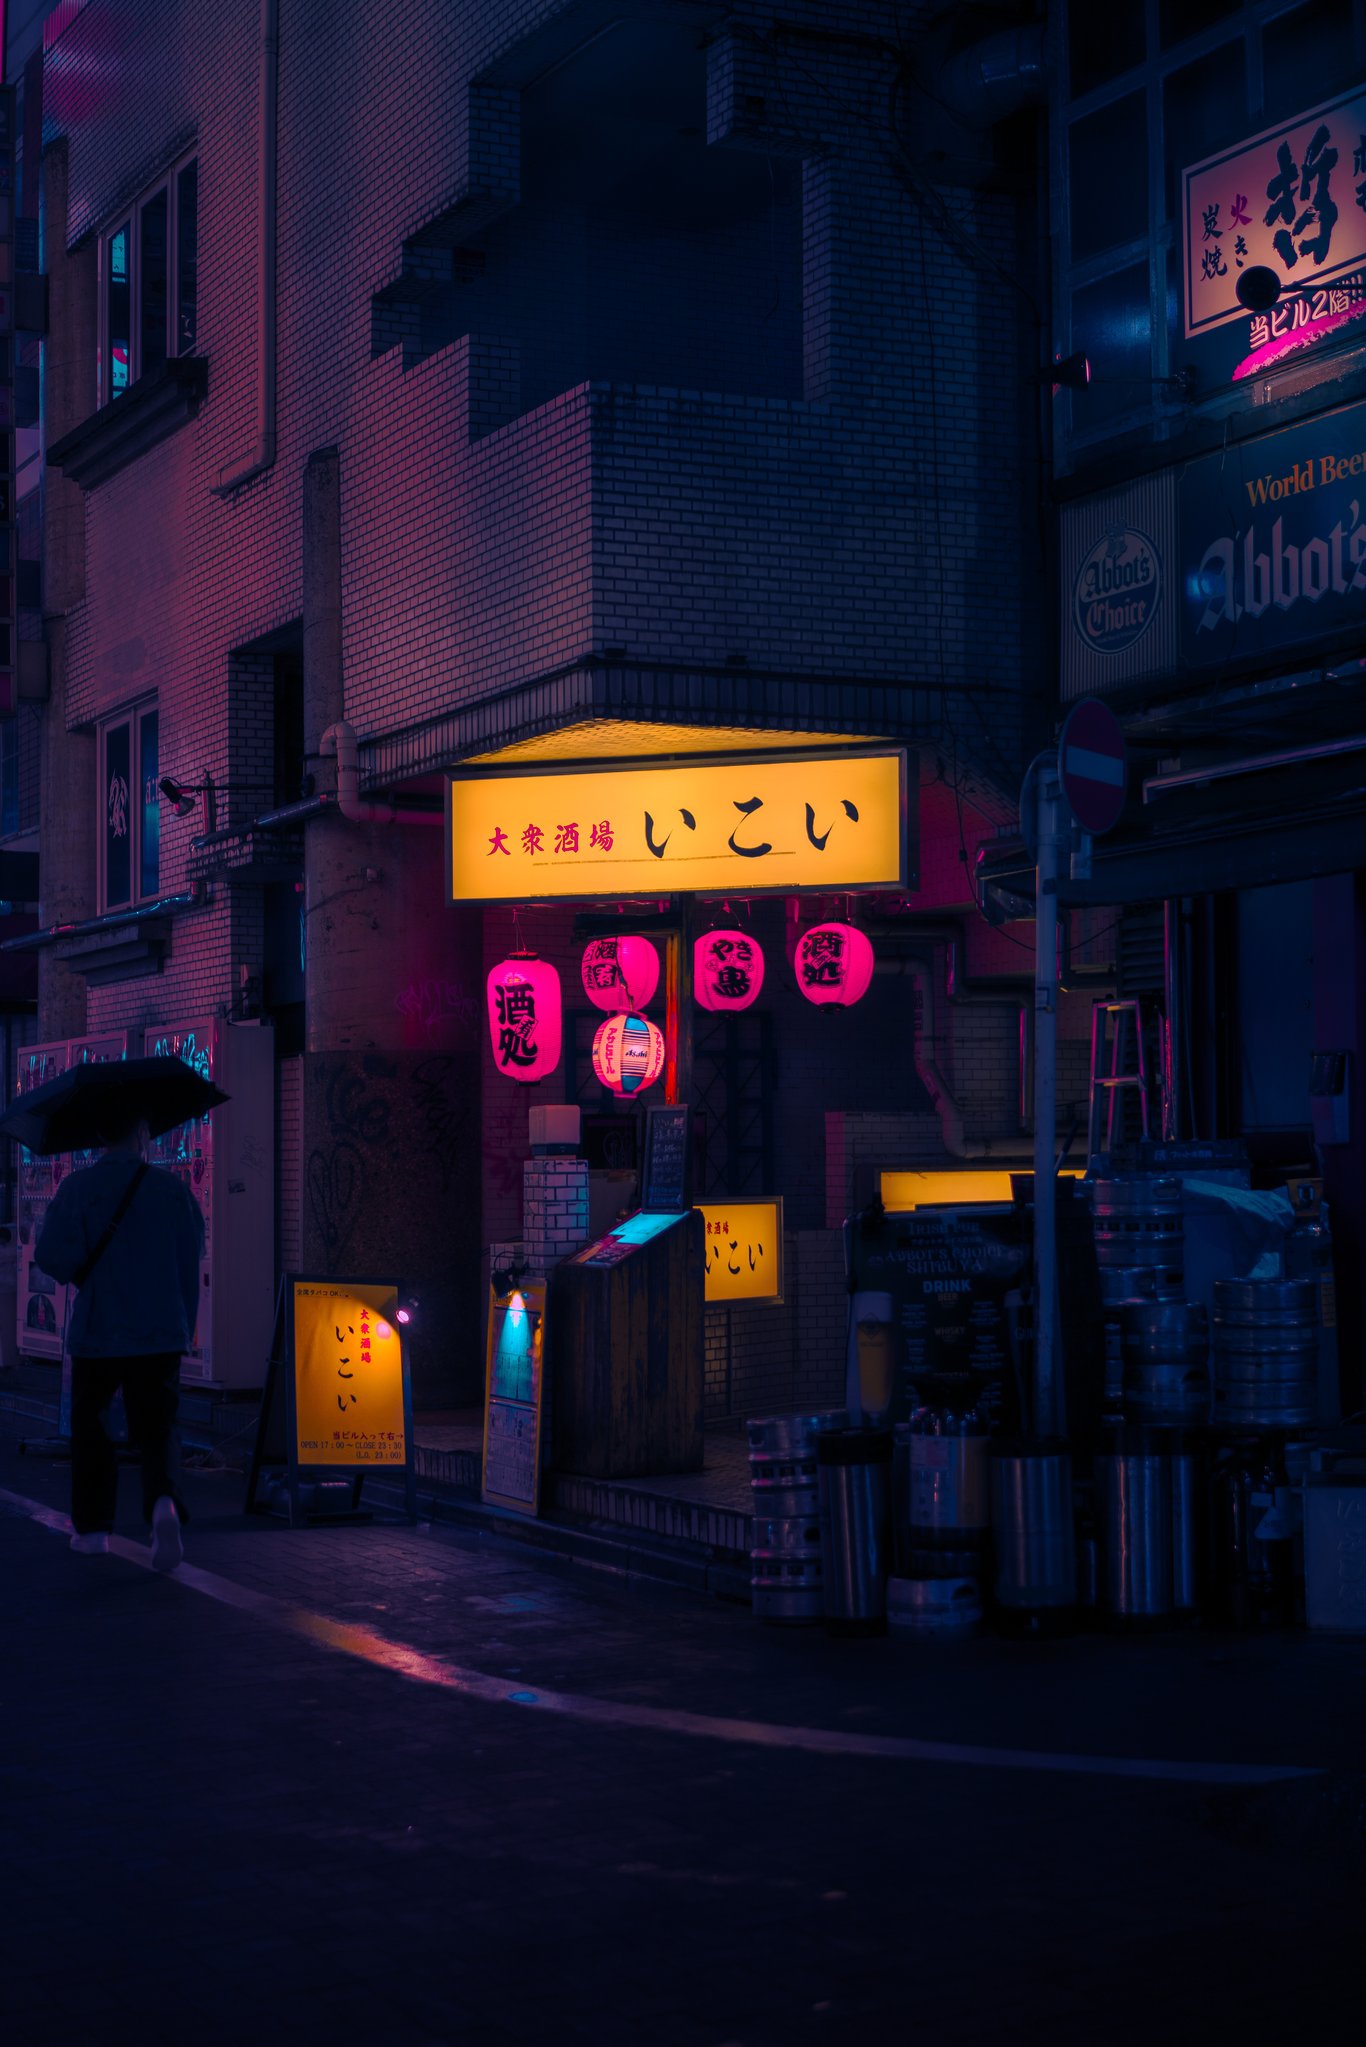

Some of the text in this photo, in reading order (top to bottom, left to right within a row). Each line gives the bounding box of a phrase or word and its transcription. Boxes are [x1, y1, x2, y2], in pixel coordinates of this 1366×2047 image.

[1246, 461, 1315, 507] World
[1085, 549, 1150, 598] Abbot's
[1086, 598, 1147, 637] Choice
[487, 796, 859, 858] 大衆酒場 いこい
[494, 983, 538, 1066] 酒処
[703, 1220, 729, 1235] 衆酒場
[922, 1279, 972, 1294] DRINK
[360, 1309, 371, 1363] 大衆酒場
[335, 1325, 357, 1412] いこい
[300, 1440, 319, 1449] OPEN
[355, 1441, 376, 1449] CLOSE
